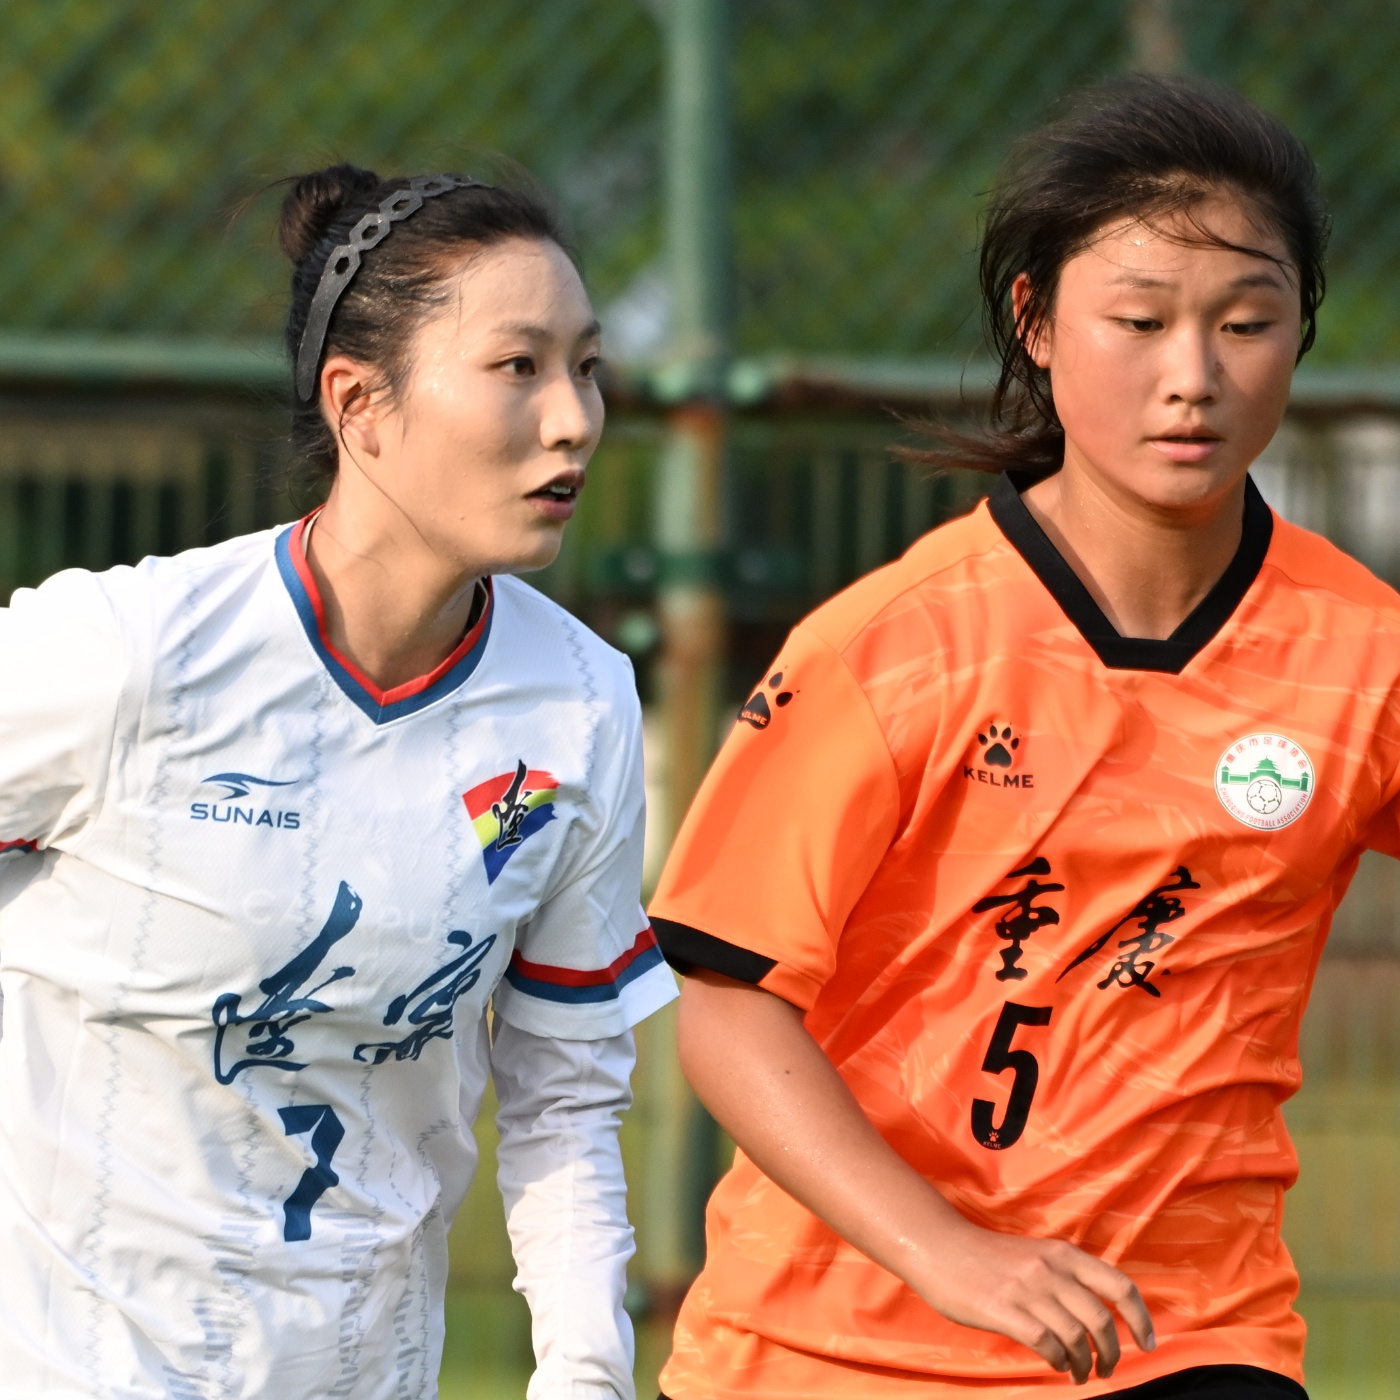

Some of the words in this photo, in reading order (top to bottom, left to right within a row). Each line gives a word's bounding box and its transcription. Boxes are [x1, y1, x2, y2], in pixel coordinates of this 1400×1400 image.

[963, 766, 1034, 789] KELME
[190, 802, 301, 830] SUNAIS
[1219, 787, 1245, 818] CHONGQING
[1245, 814, 1276, 827] FOOTBALL
[1277, 793, 1309, 826] ASSOCIATION
[970, 1001, 1052, 1151] 5
[277, 1104, 346, 1242] 7
